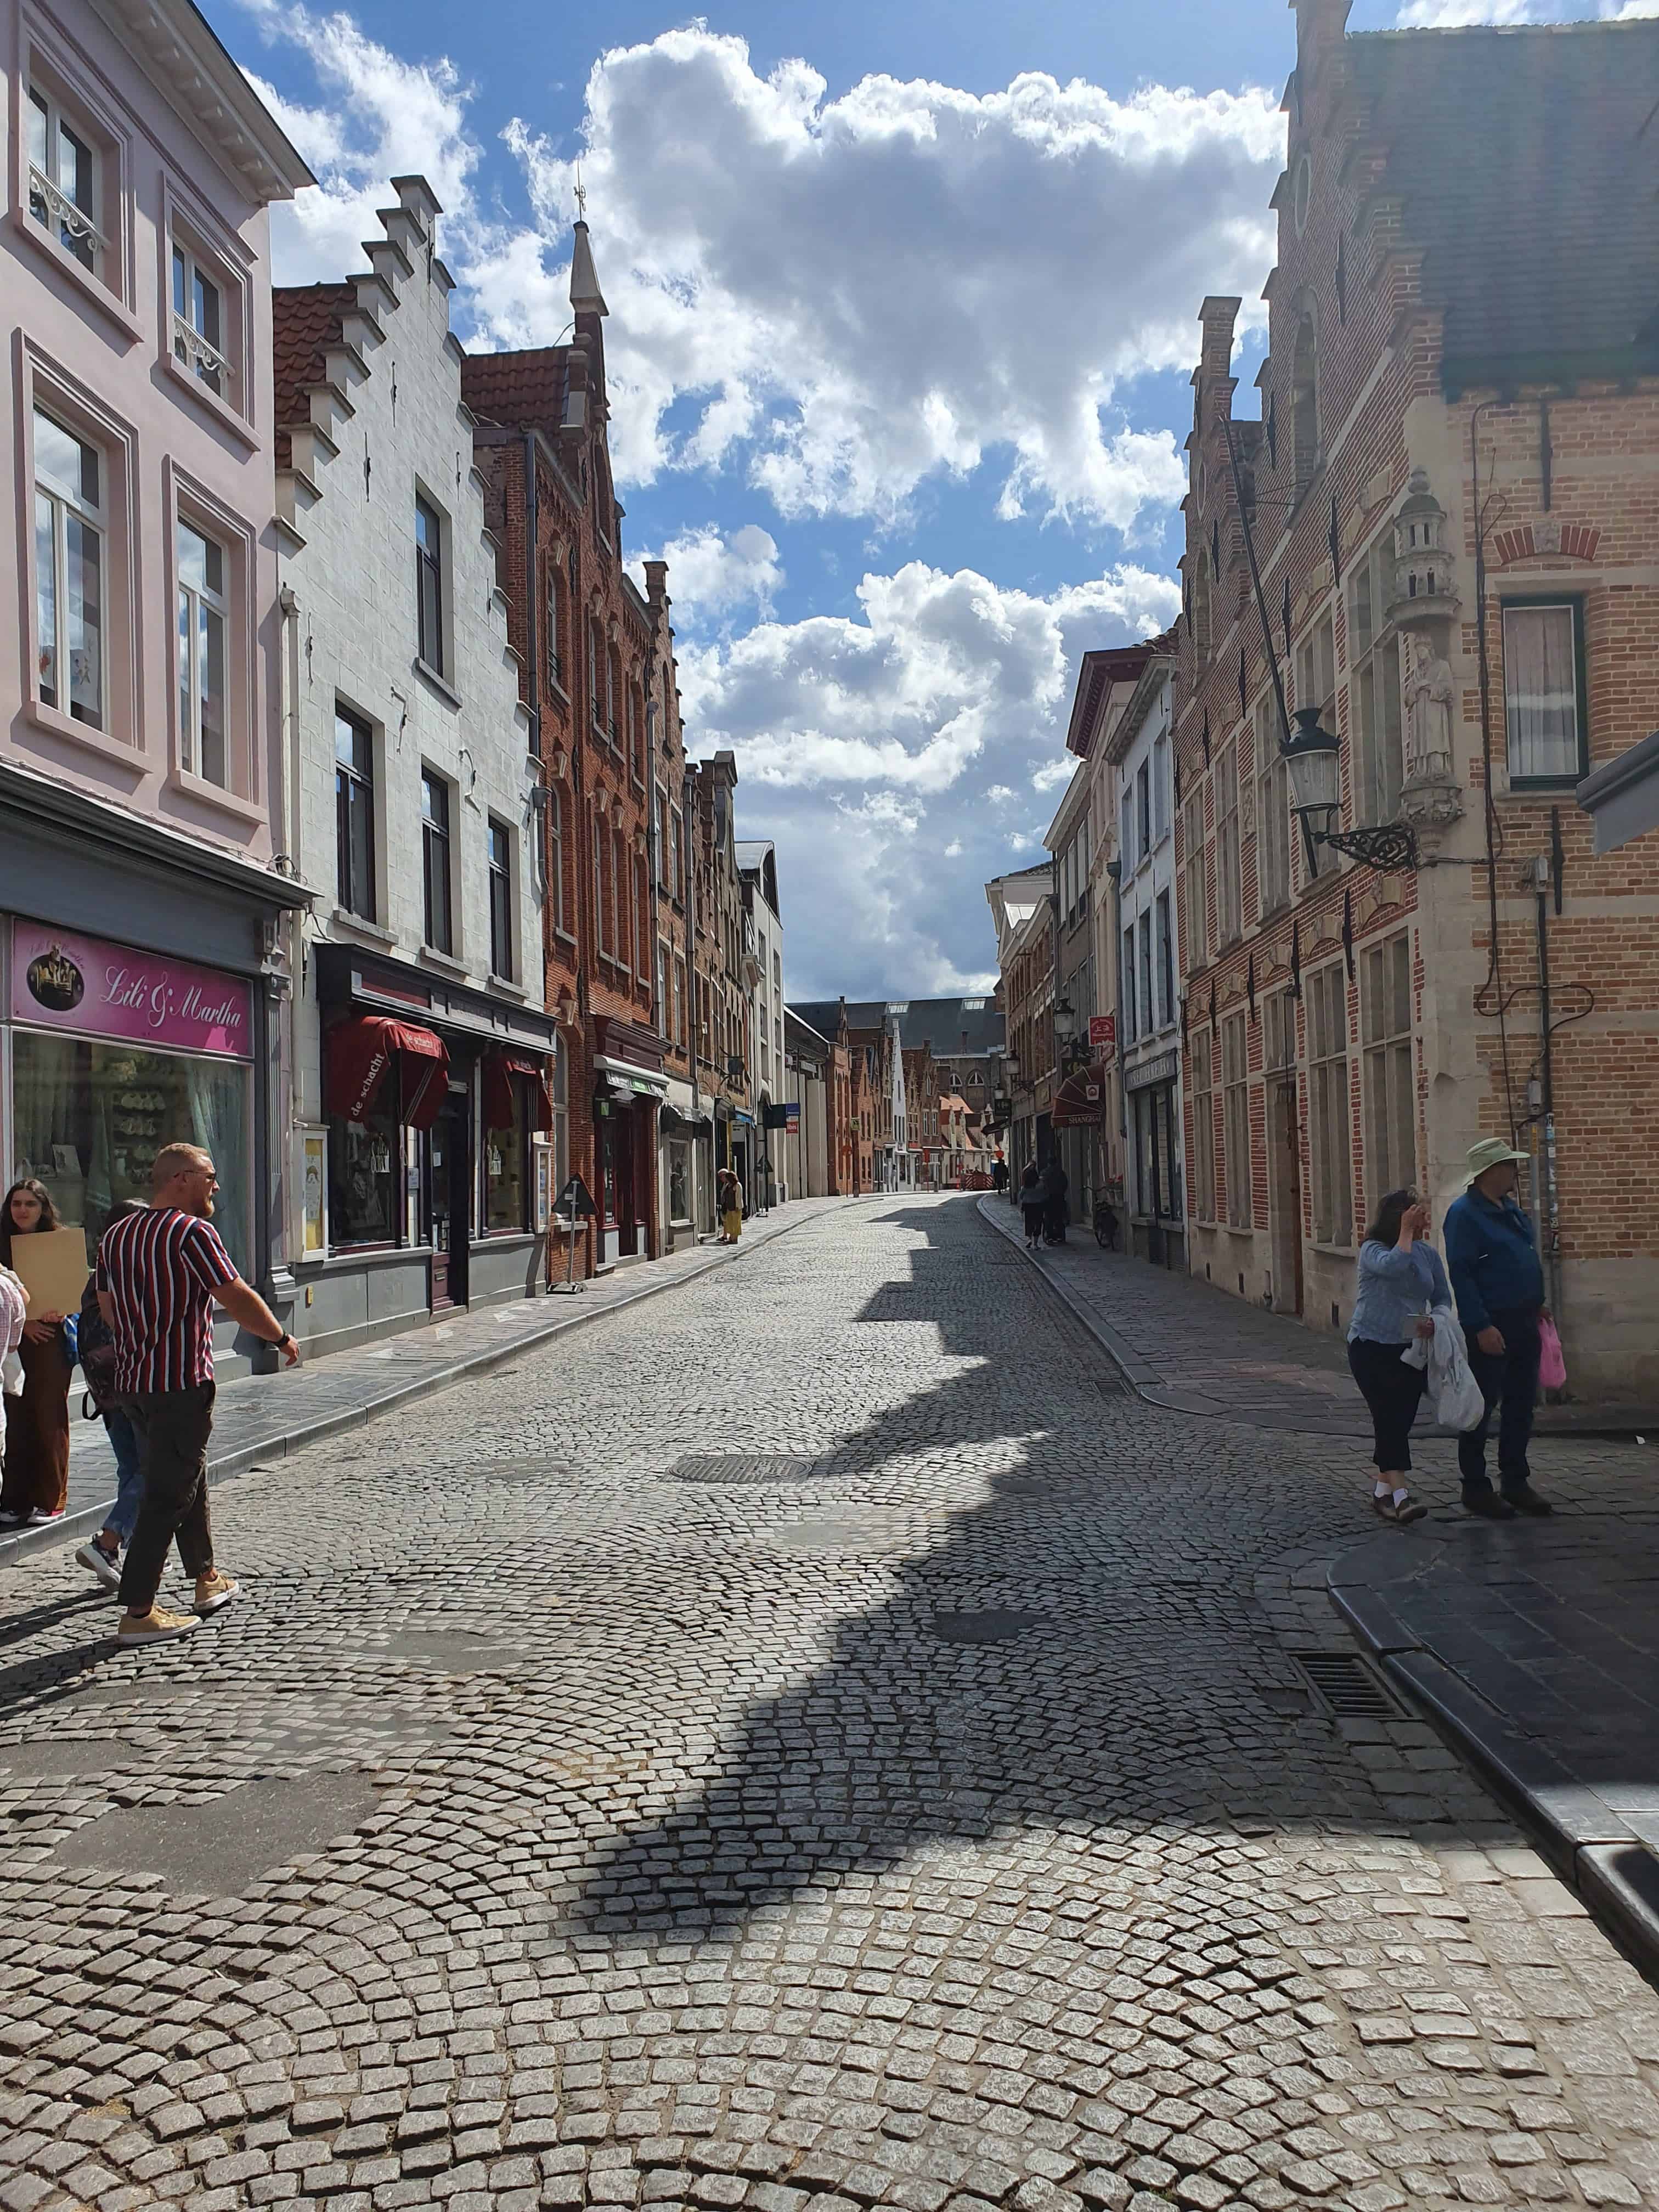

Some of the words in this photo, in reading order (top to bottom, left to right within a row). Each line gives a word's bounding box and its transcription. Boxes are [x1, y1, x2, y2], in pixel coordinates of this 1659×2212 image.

[100, 966, 148, 1009] Lili
[148, 972, 173, 1027] &
[170, 985, 242, 1028] Martha
[351, 1101, 364, 1116] de
[360, 1053, 385, 1098] schacht
[1068, 1115, 1101, 1124] SHANGHAI
